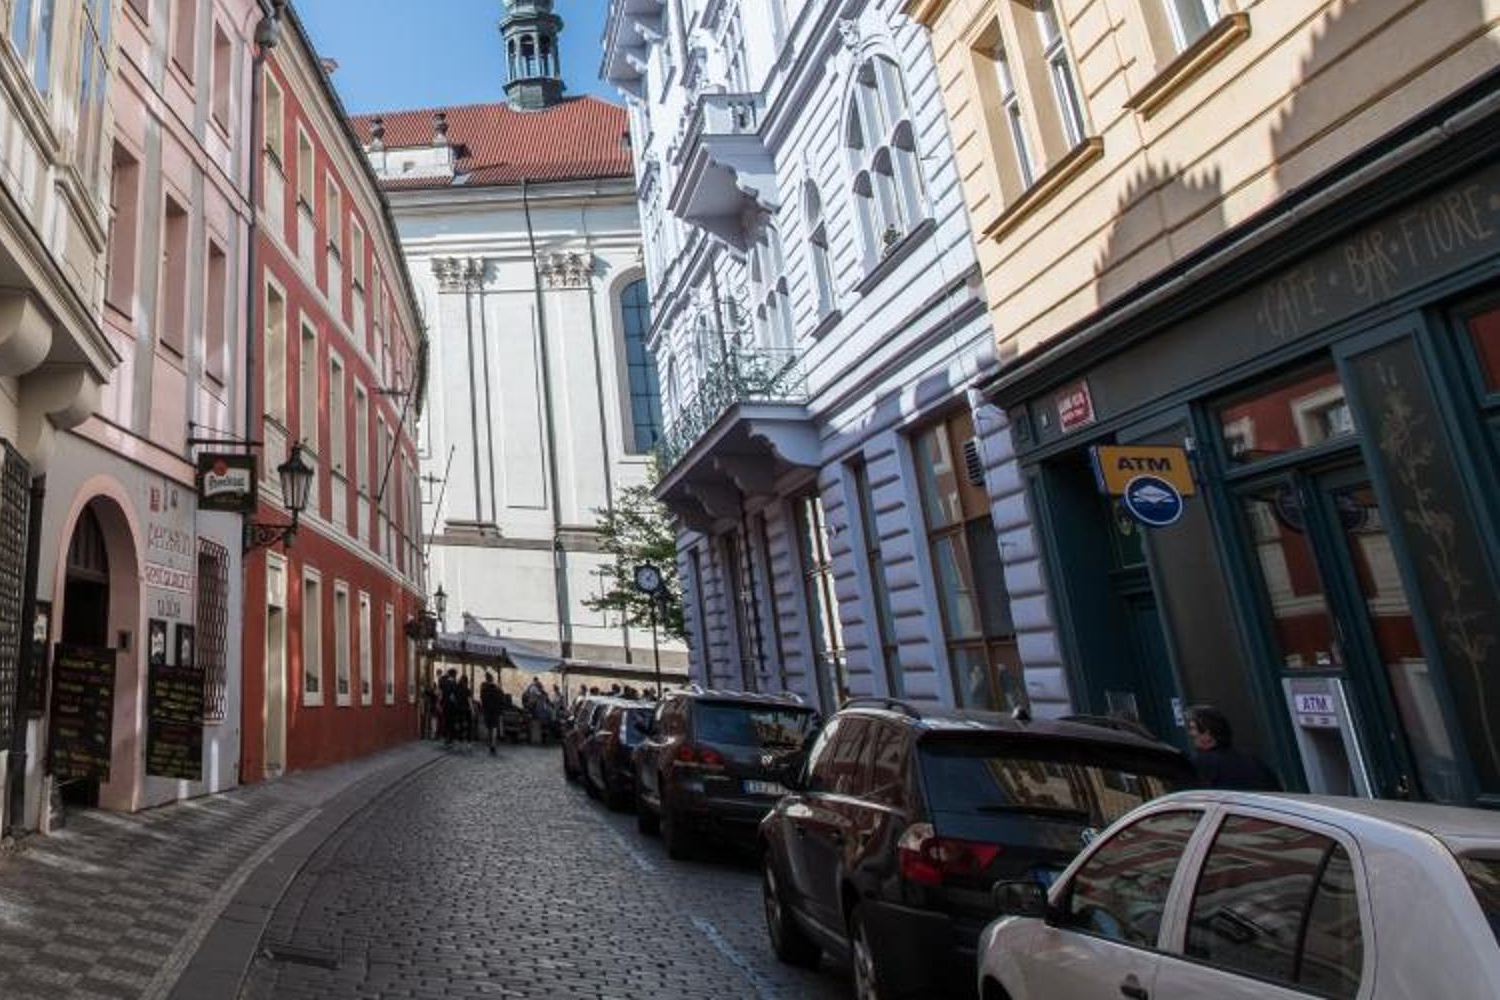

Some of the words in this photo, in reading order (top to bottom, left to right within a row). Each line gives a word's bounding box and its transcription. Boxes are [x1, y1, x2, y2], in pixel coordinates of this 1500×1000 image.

[1346, 230, 1398, 300] BAR
[1117, 456, 1172, 471] ATM
[1302, 696, 1329, 711] ATM
